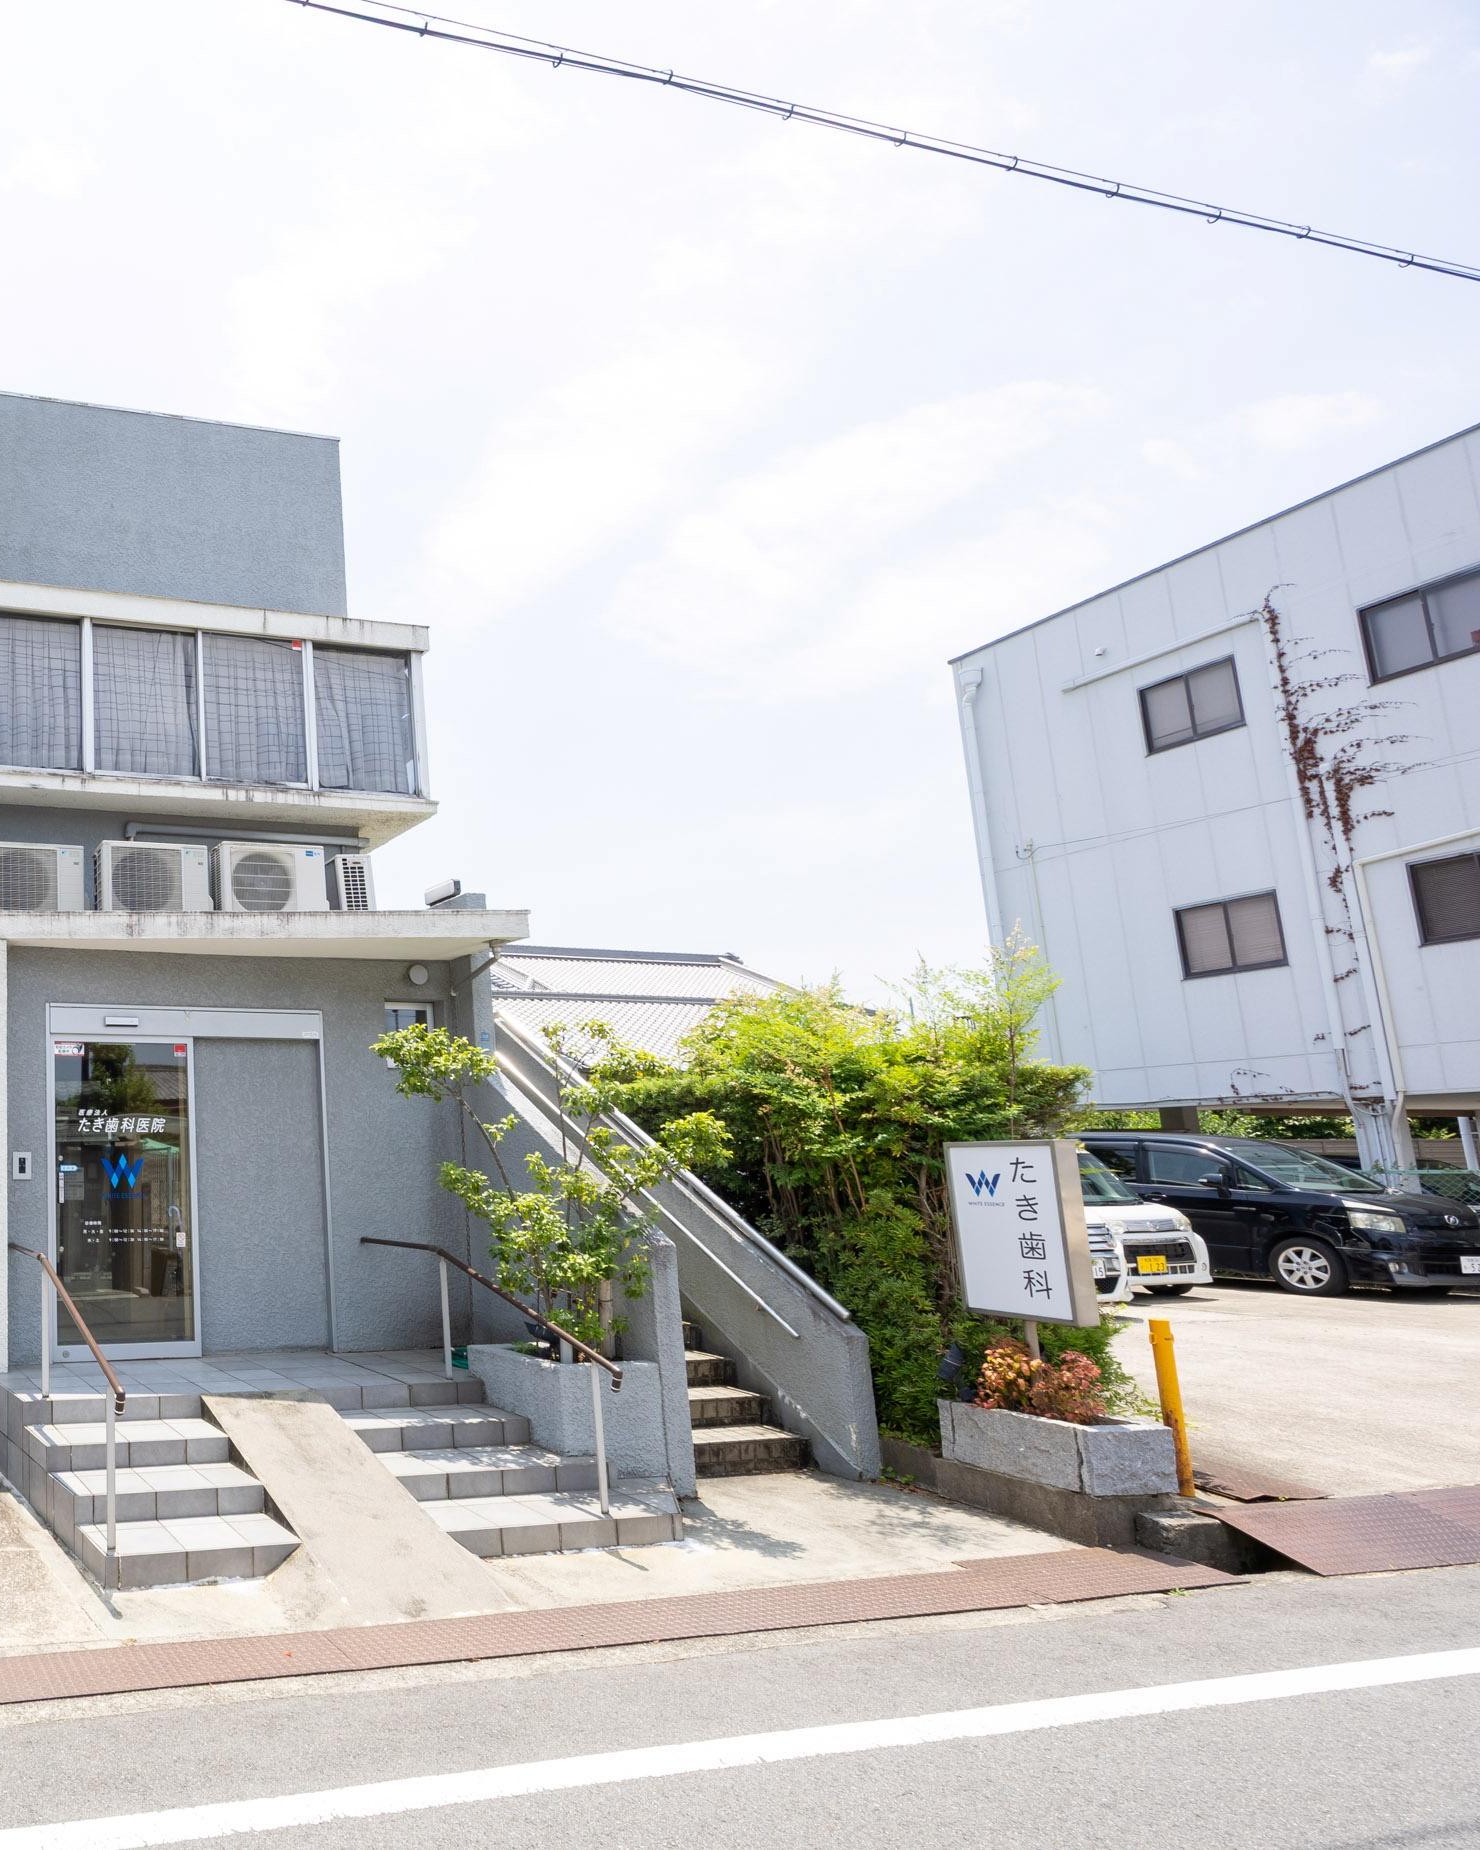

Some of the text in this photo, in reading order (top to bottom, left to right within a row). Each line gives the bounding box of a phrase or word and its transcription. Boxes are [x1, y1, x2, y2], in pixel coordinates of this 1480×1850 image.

[77, 1117, 167, 1134] たき歯科医院
[1009, 1156, 1053, 1300] たき歯科
